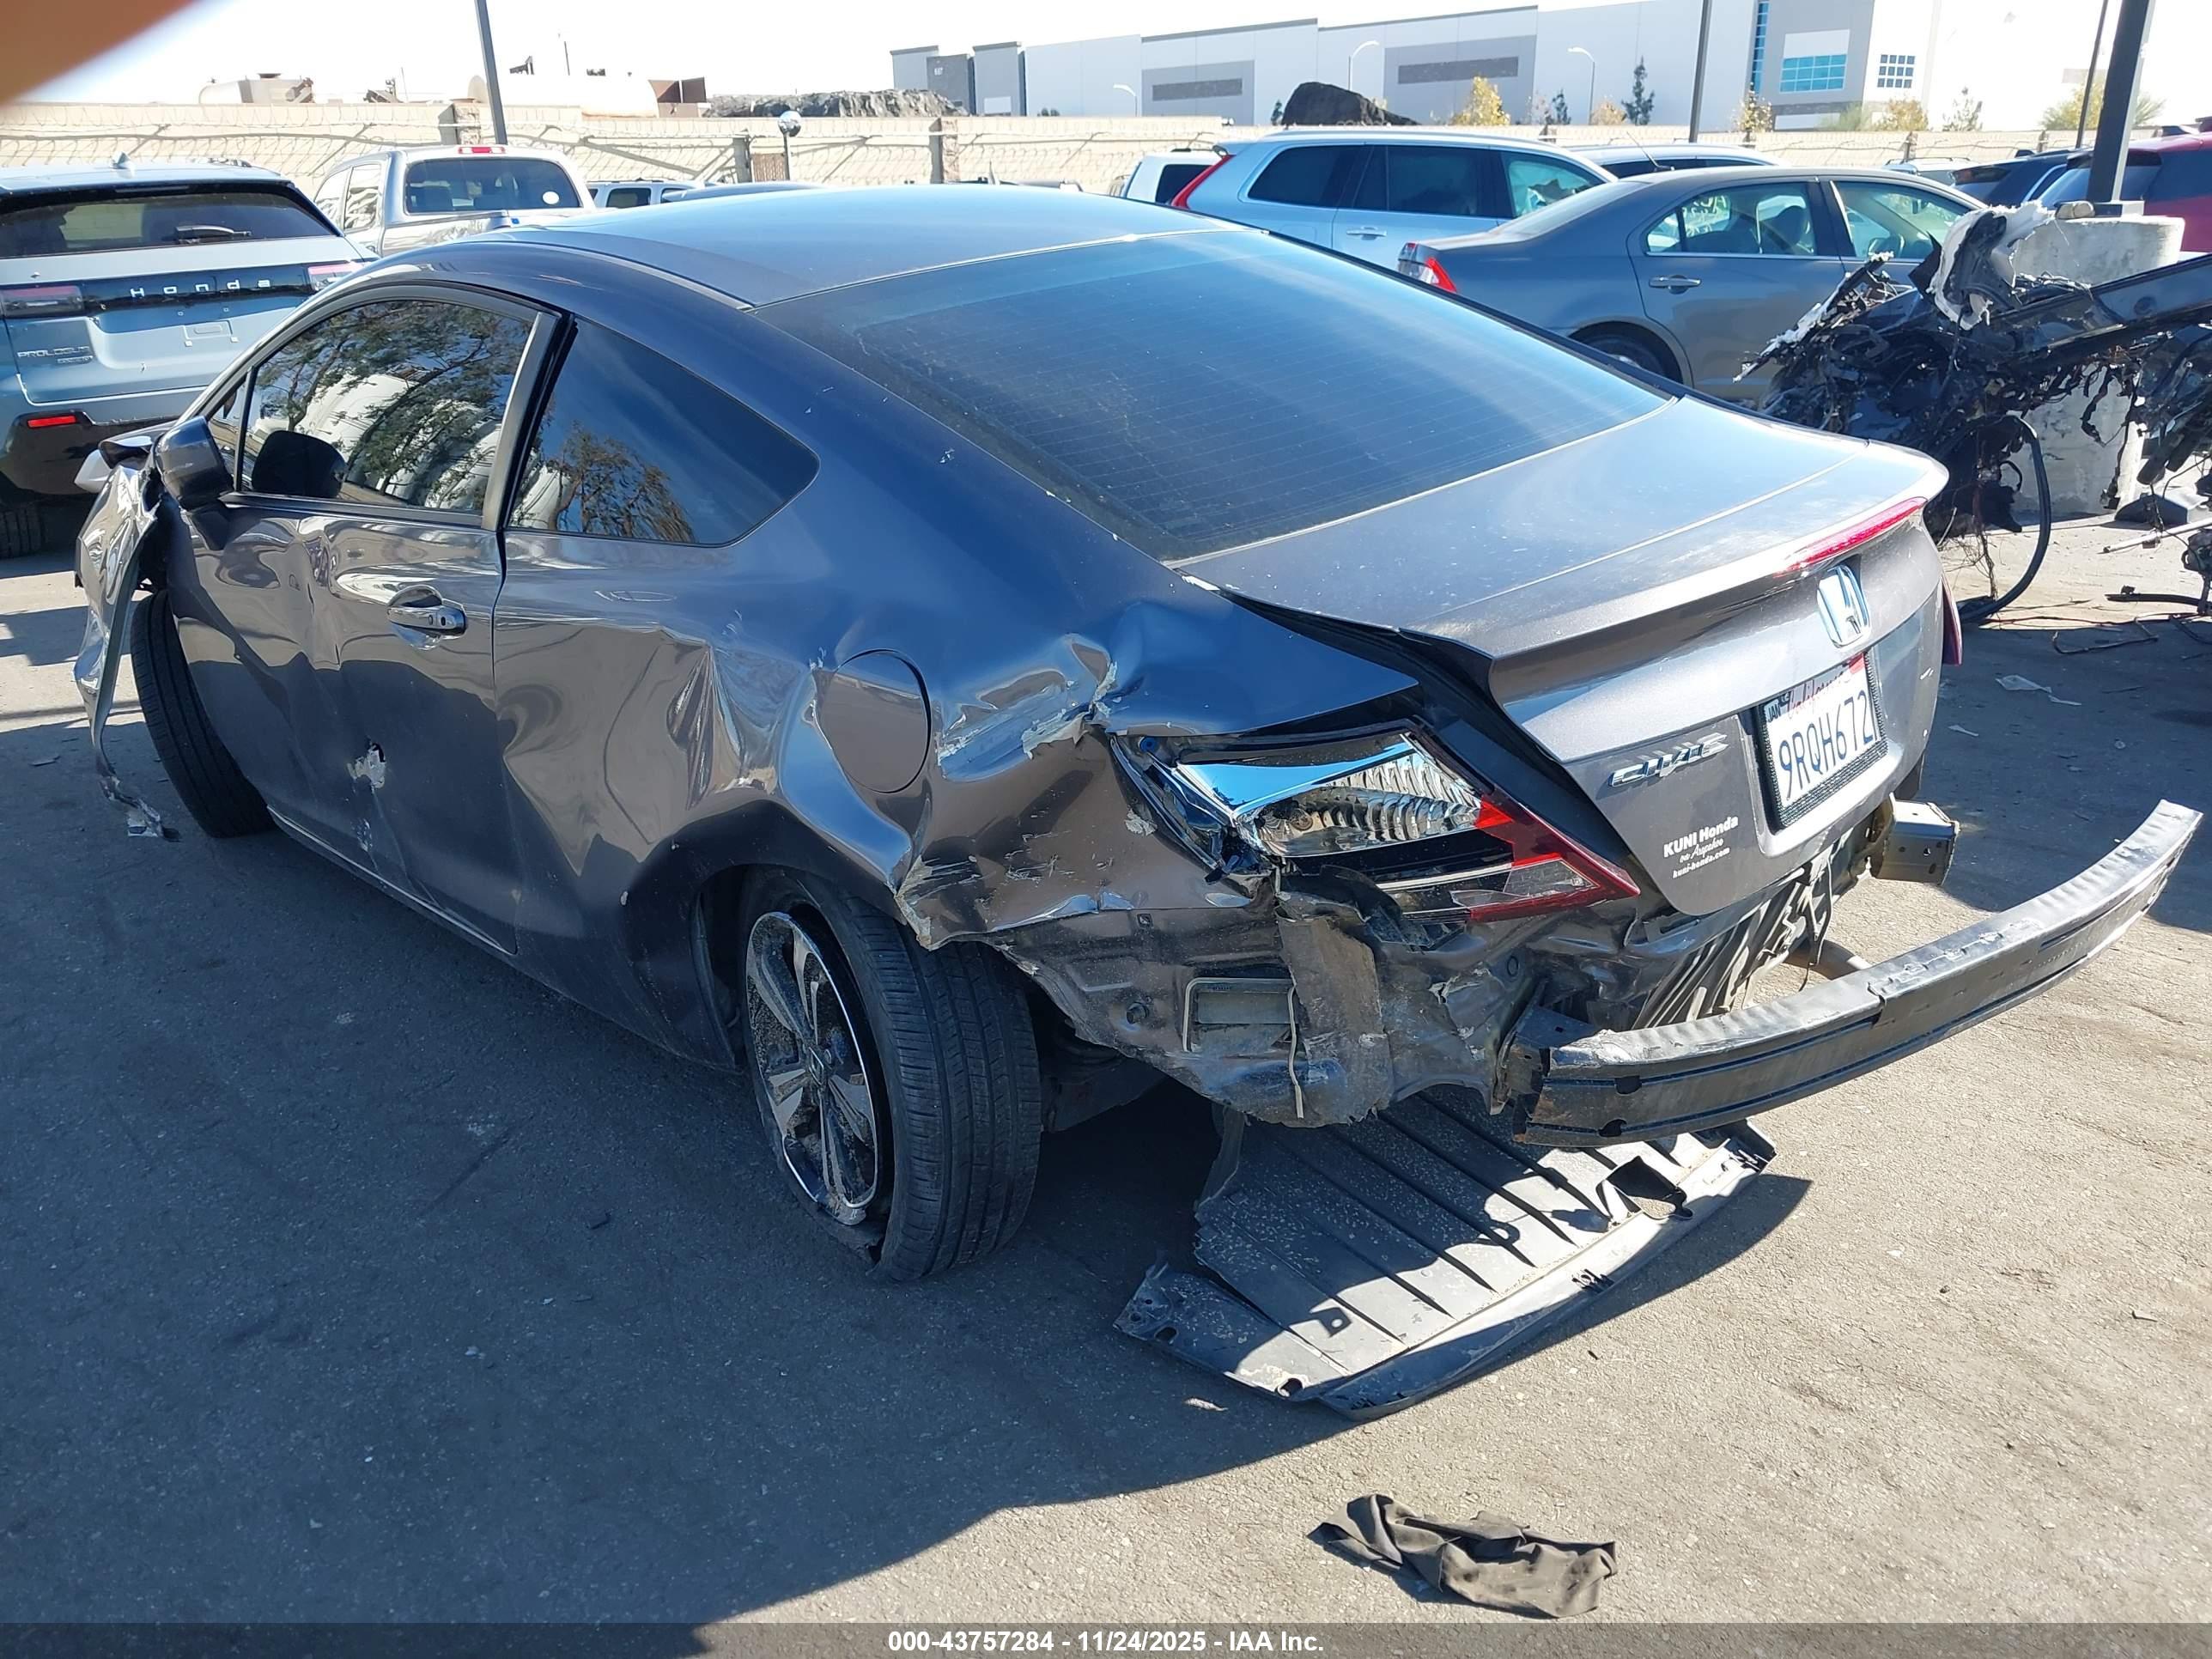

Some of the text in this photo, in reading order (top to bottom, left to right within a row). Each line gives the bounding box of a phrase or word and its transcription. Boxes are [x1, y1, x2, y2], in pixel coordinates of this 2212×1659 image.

[130, 279, 270, 298] Honda
[1767, 703, 1782, 723] JAN
[1607, 732, 1729, 787] CIVIC
[1778, 690, 1874, 801] 9RQH672
[1663, 816, 1739, 858] KUNI Honda
[1673, 848, 1730, 878] kuni-honda.com
